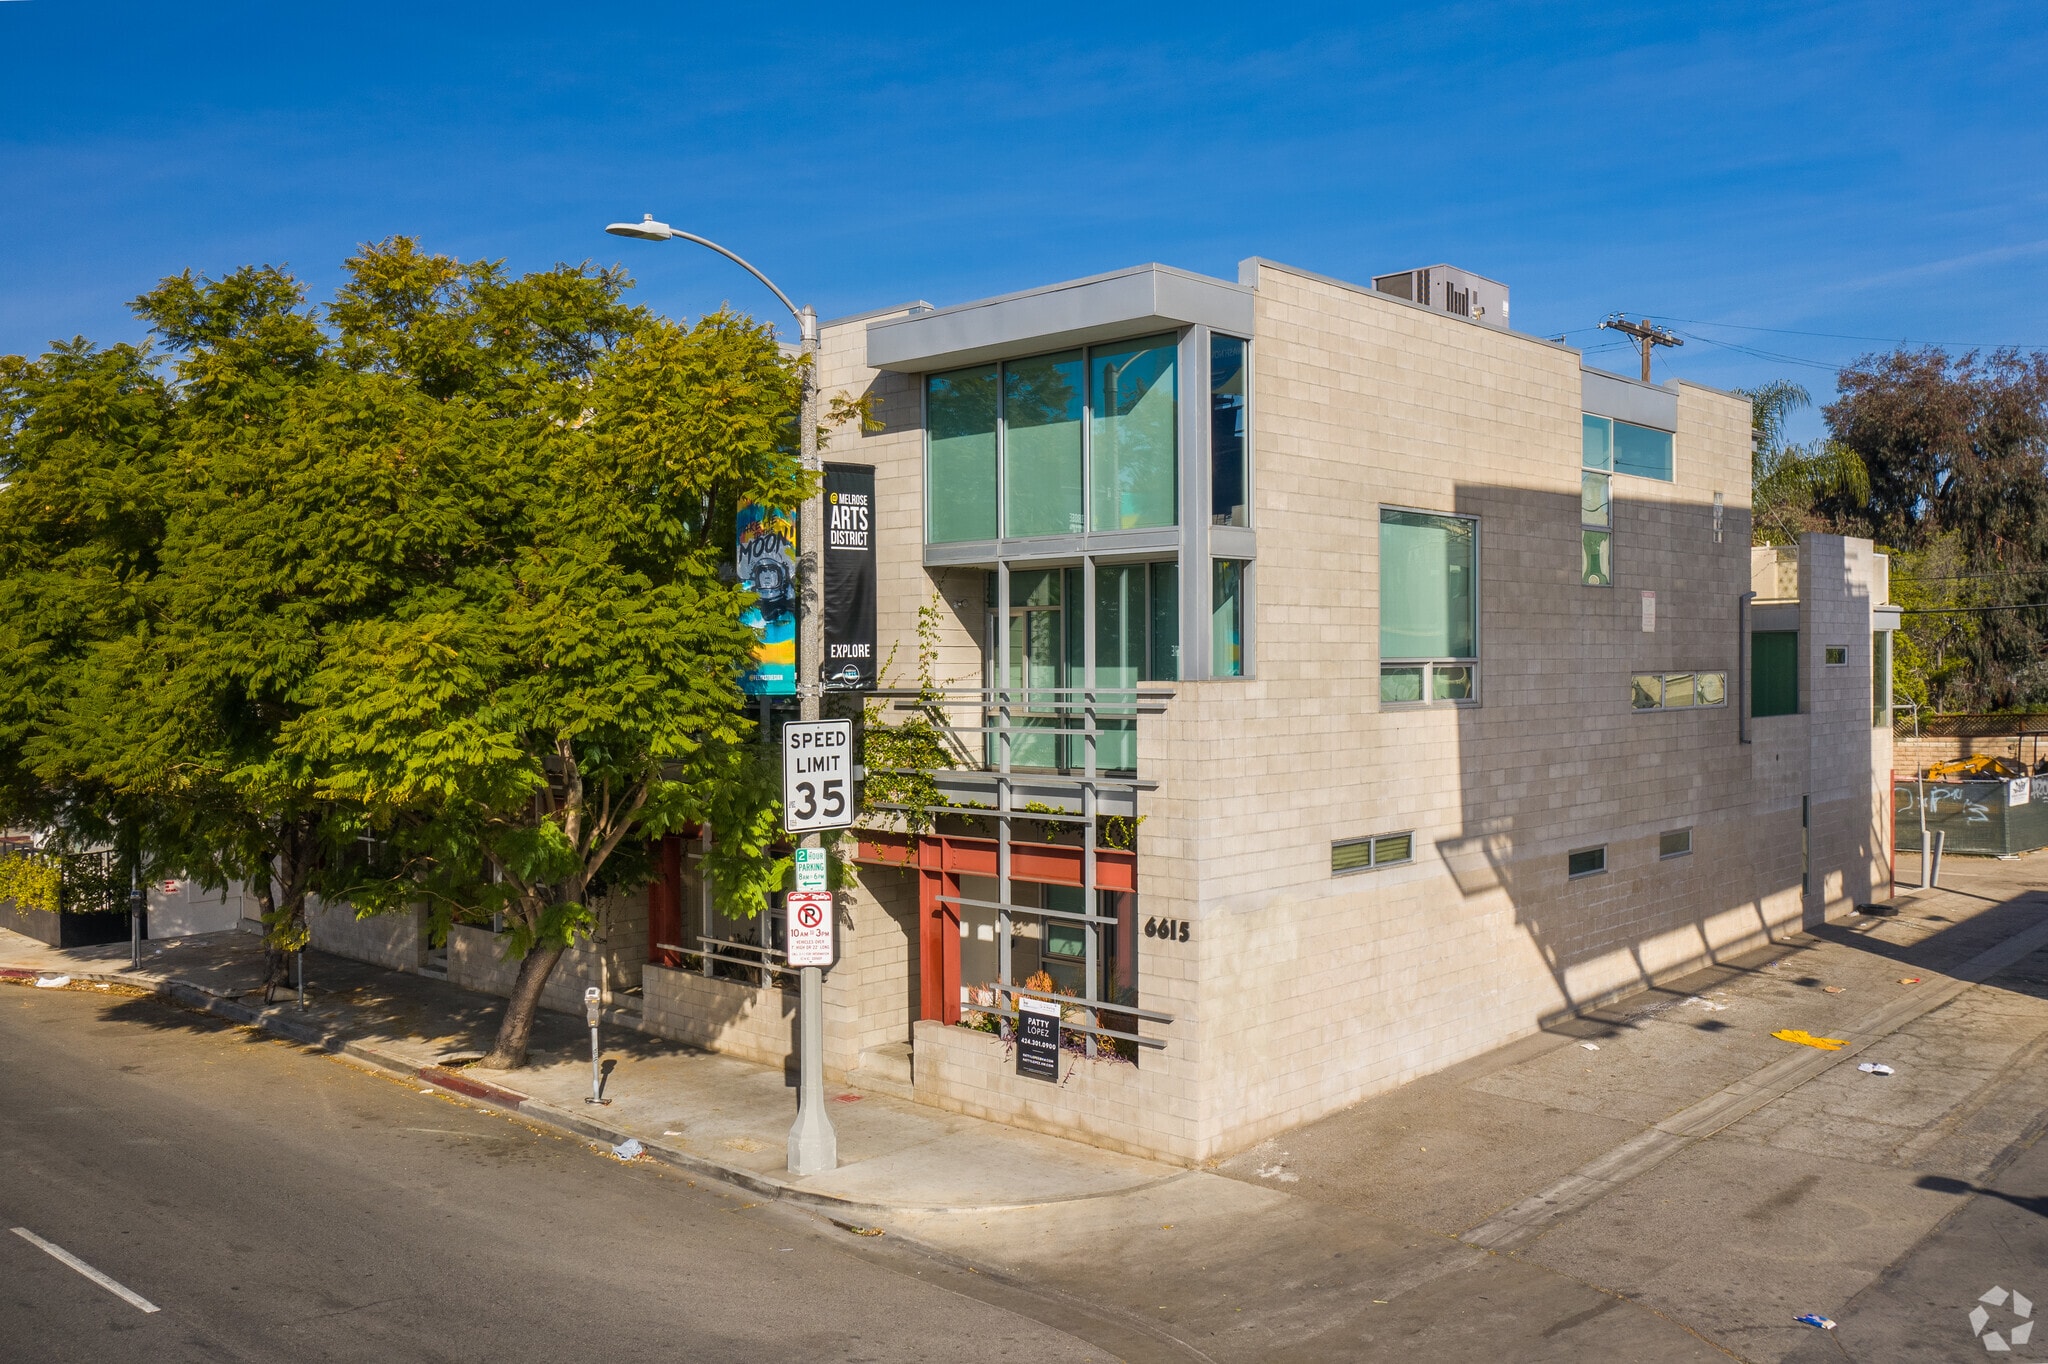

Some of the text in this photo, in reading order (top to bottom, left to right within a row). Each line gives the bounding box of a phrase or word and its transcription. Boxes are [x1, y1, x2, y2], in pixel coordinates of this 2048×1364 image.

[831, 505, 869, 531] ARTS
[831, 530, 869, 546] DISTRICT
[830, 643, 871, 658] EXPLORE
[790, 731, 846, 749] SPEED
[796, 755, 840, 773] LIMIT
[794, 779, 845, 820] 35
[798, 850, 824, 861] 2 HOUR
[798, 863, 825, 872] PARKING
[1144, 916, 1190, 943] 6615
[1027, 1017, 1050, 1028] PATTY
[1020, 1037, 1057, 1051] 424.301.0900
